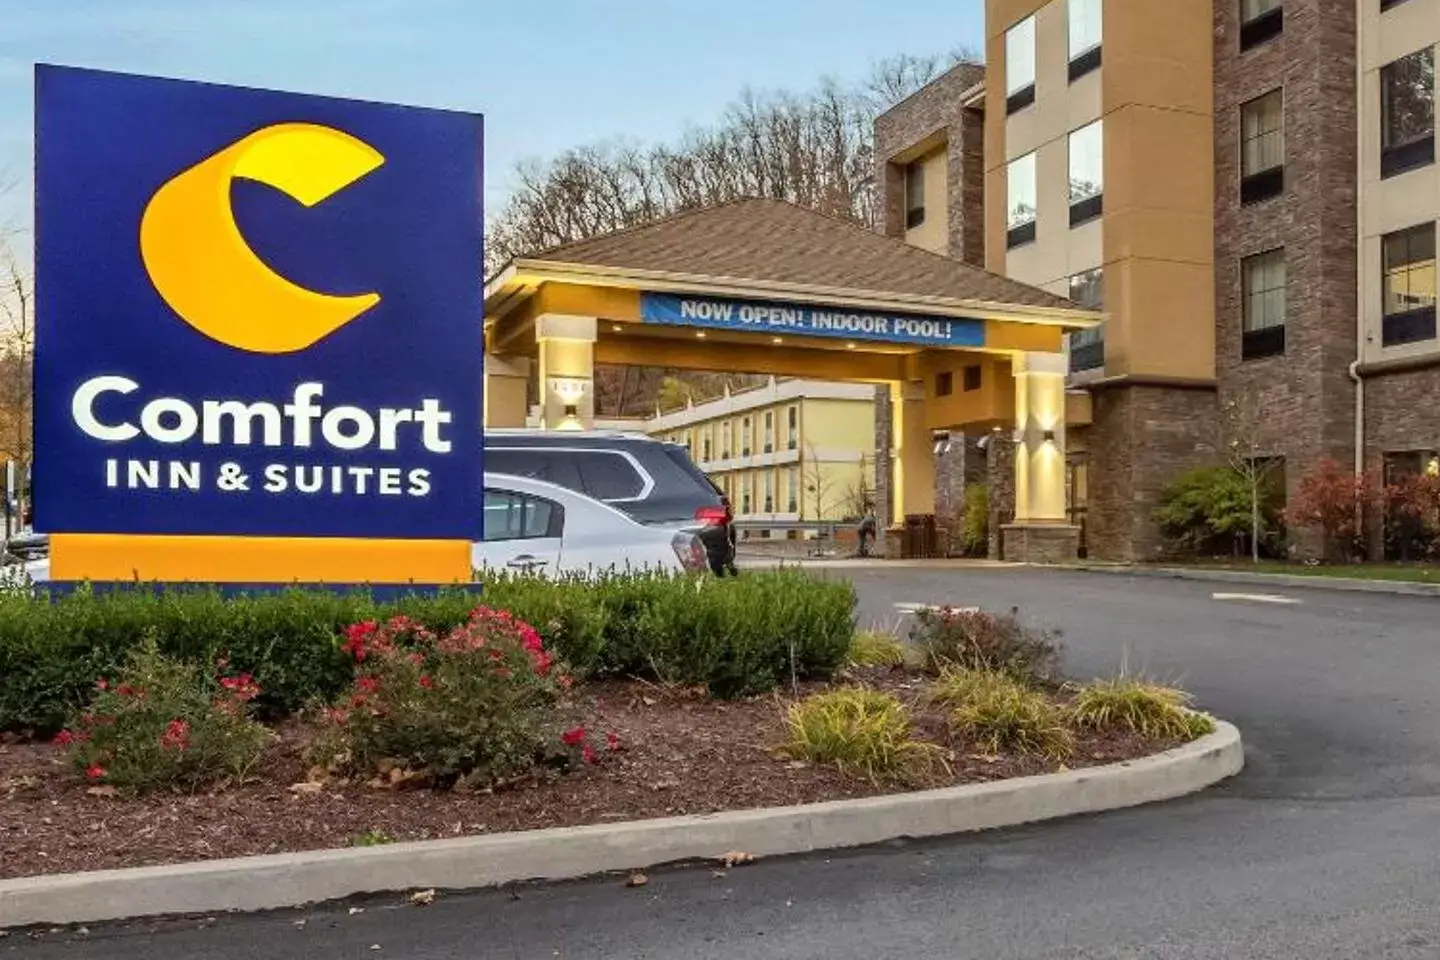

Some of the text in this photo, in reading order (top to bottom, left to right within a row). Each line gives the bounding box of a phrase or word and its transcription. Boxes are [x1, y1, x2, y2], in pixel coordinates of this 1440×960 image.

[681, 300, 953, 339] NOW OPEN! INDOOR POOL!
[72, 375, 452, 454] Comfort
[106, 458, 431, 496] INN & SUITES
